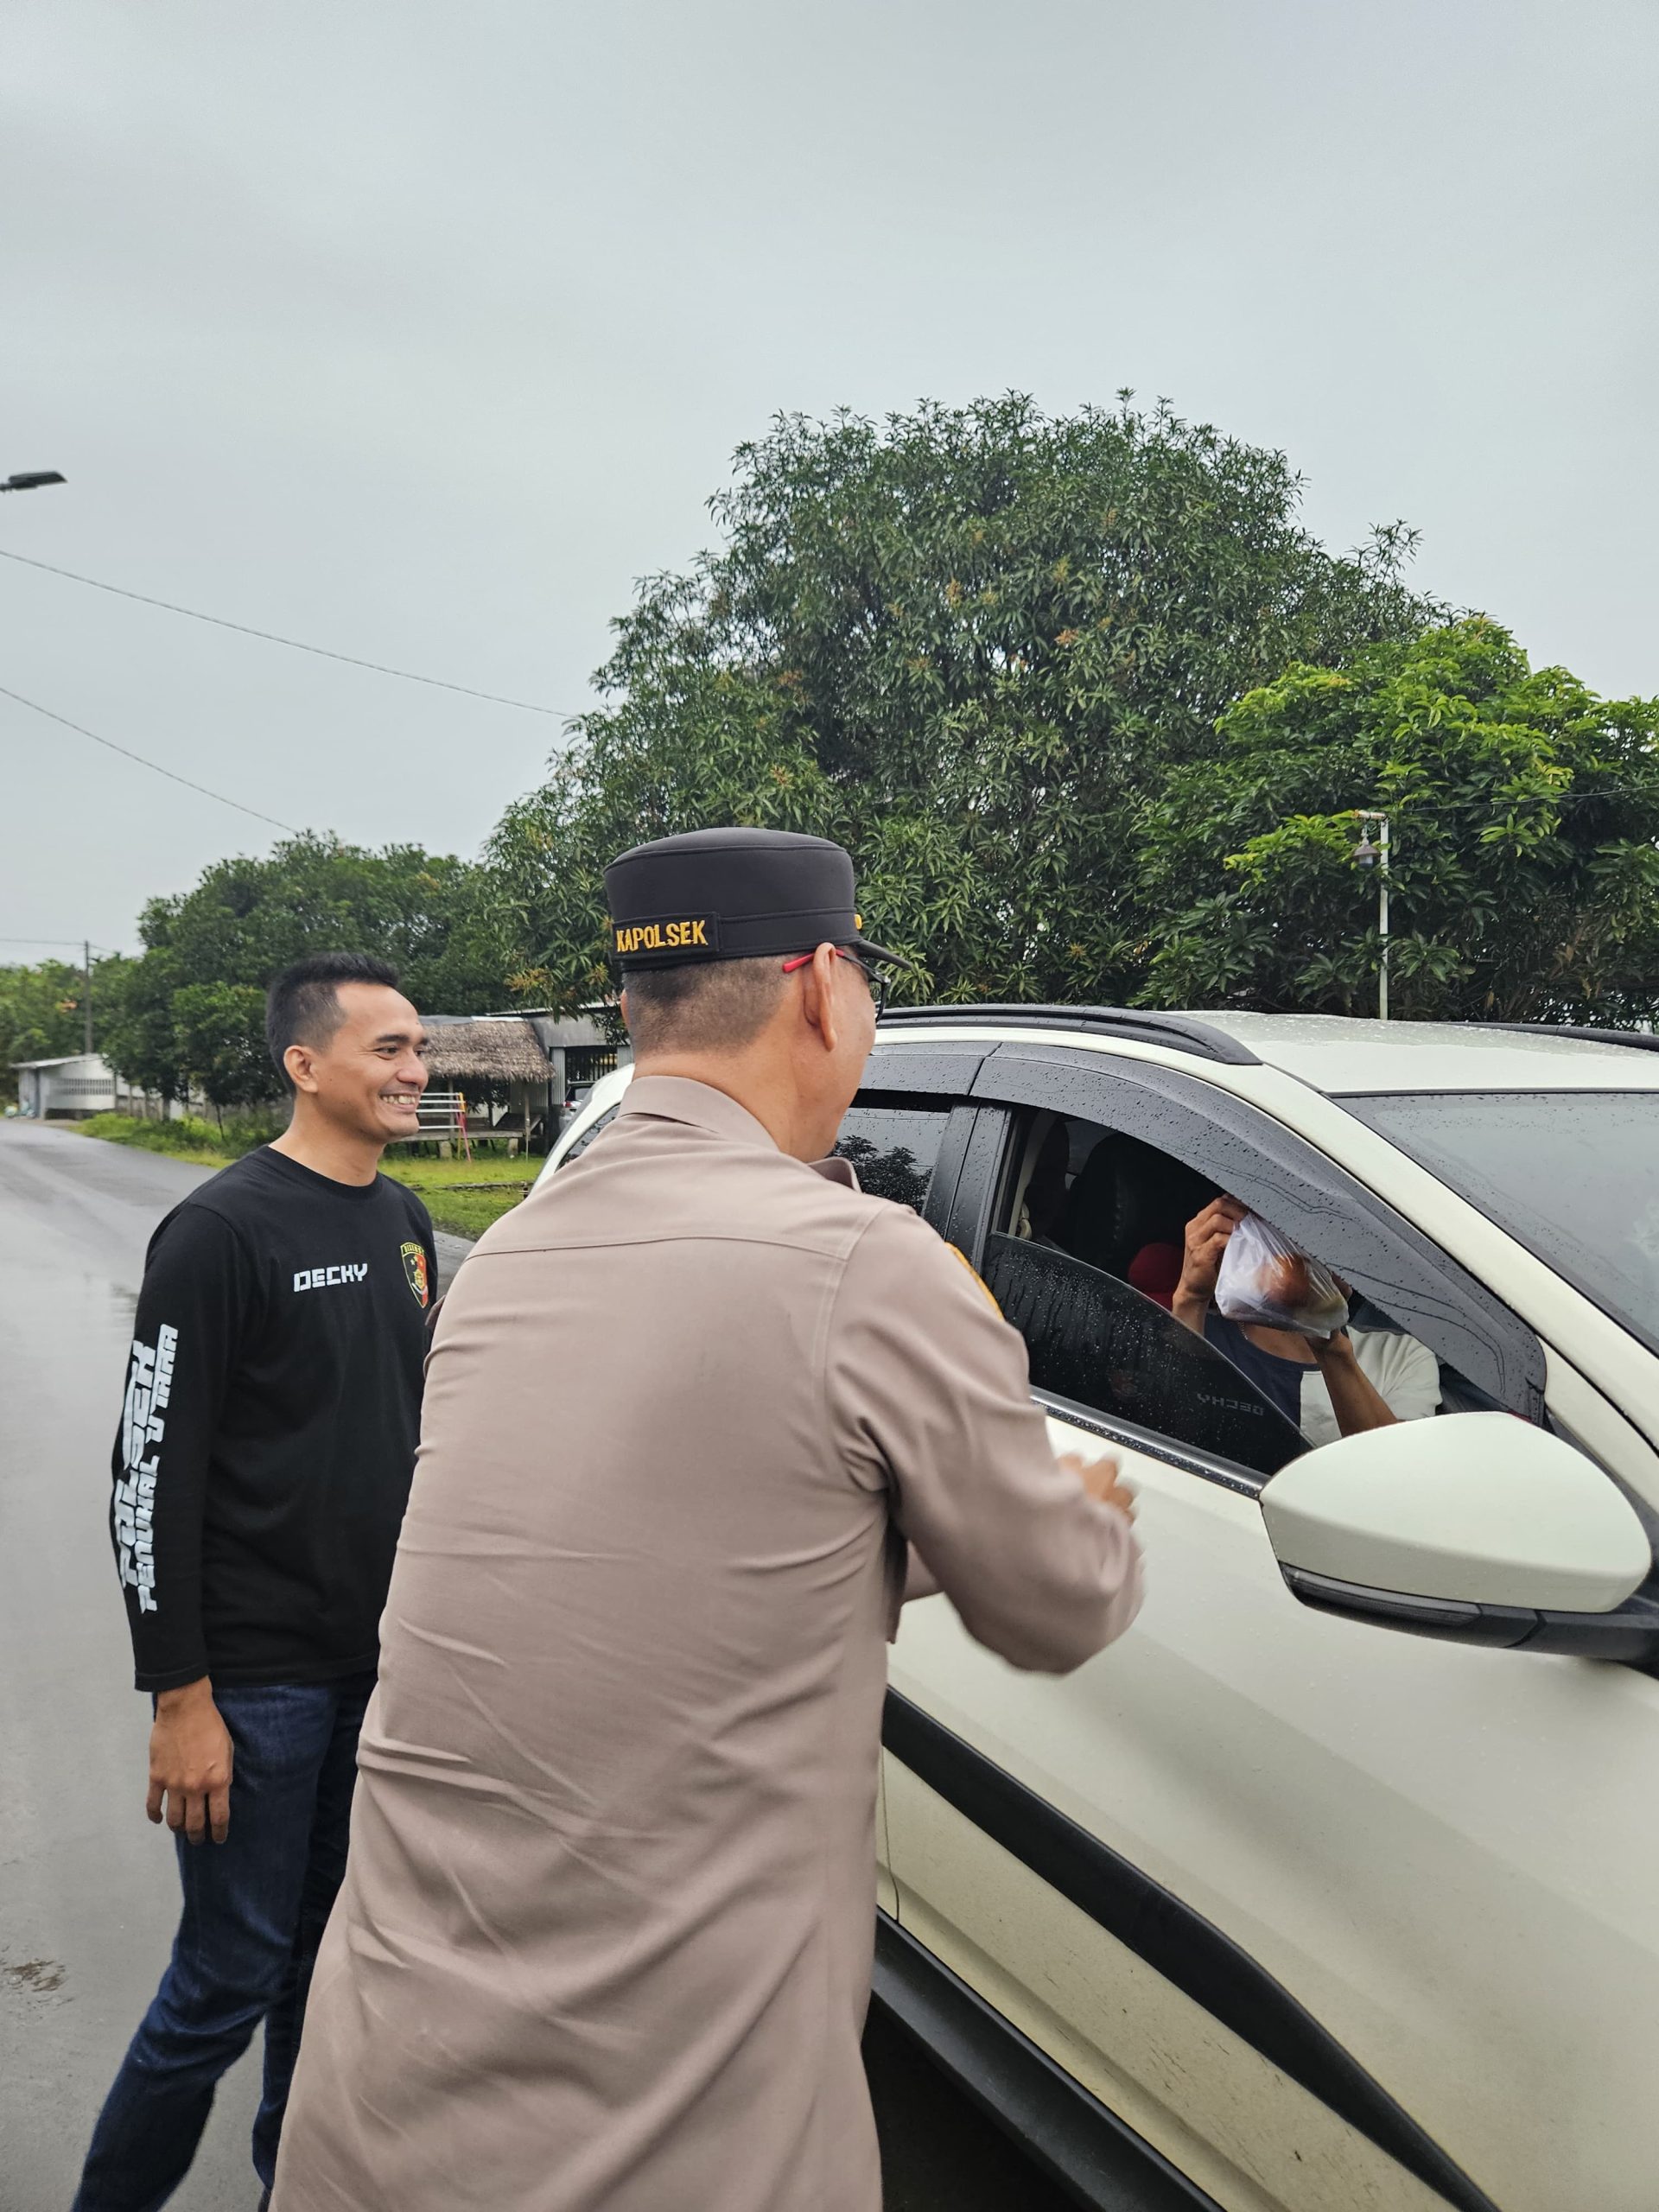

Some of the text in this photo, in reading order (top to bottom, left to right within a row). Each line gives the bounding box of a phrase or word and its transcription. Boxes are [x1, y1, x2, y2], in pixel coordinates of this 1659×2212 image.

[616, 919, 709, 952] KAPOLSEK
[294, 1262, 368, 1293] DECKY
[135, 1455, 160, 1614] PENUKAL
